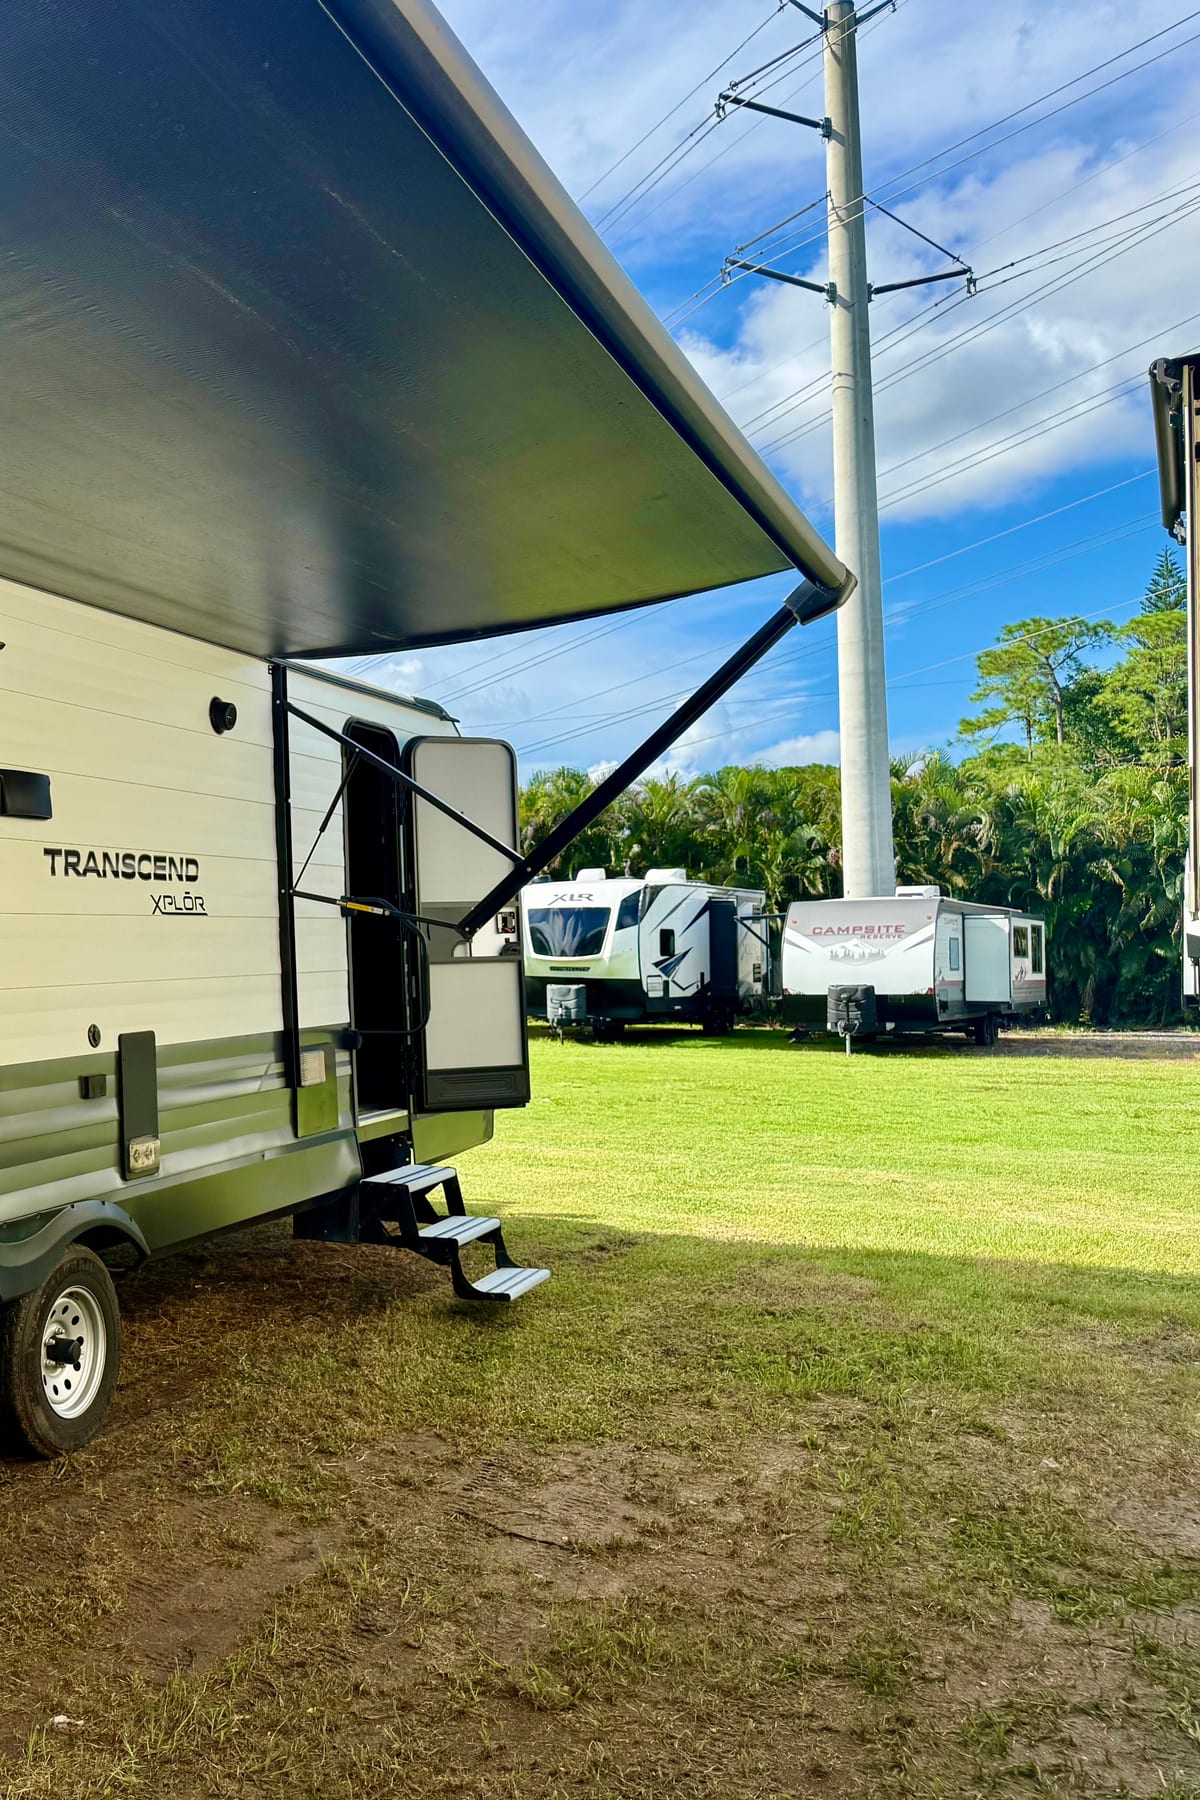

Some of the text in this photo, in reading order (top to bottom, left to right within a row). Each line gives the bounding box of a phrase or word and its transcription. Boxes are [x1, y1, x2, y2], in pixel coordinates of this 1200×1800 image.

[43, 847, 199, 882] TRANSCEND
[547, 893, 594, 906] XLR
[812, 924, 905, 936] CAMPSITE
